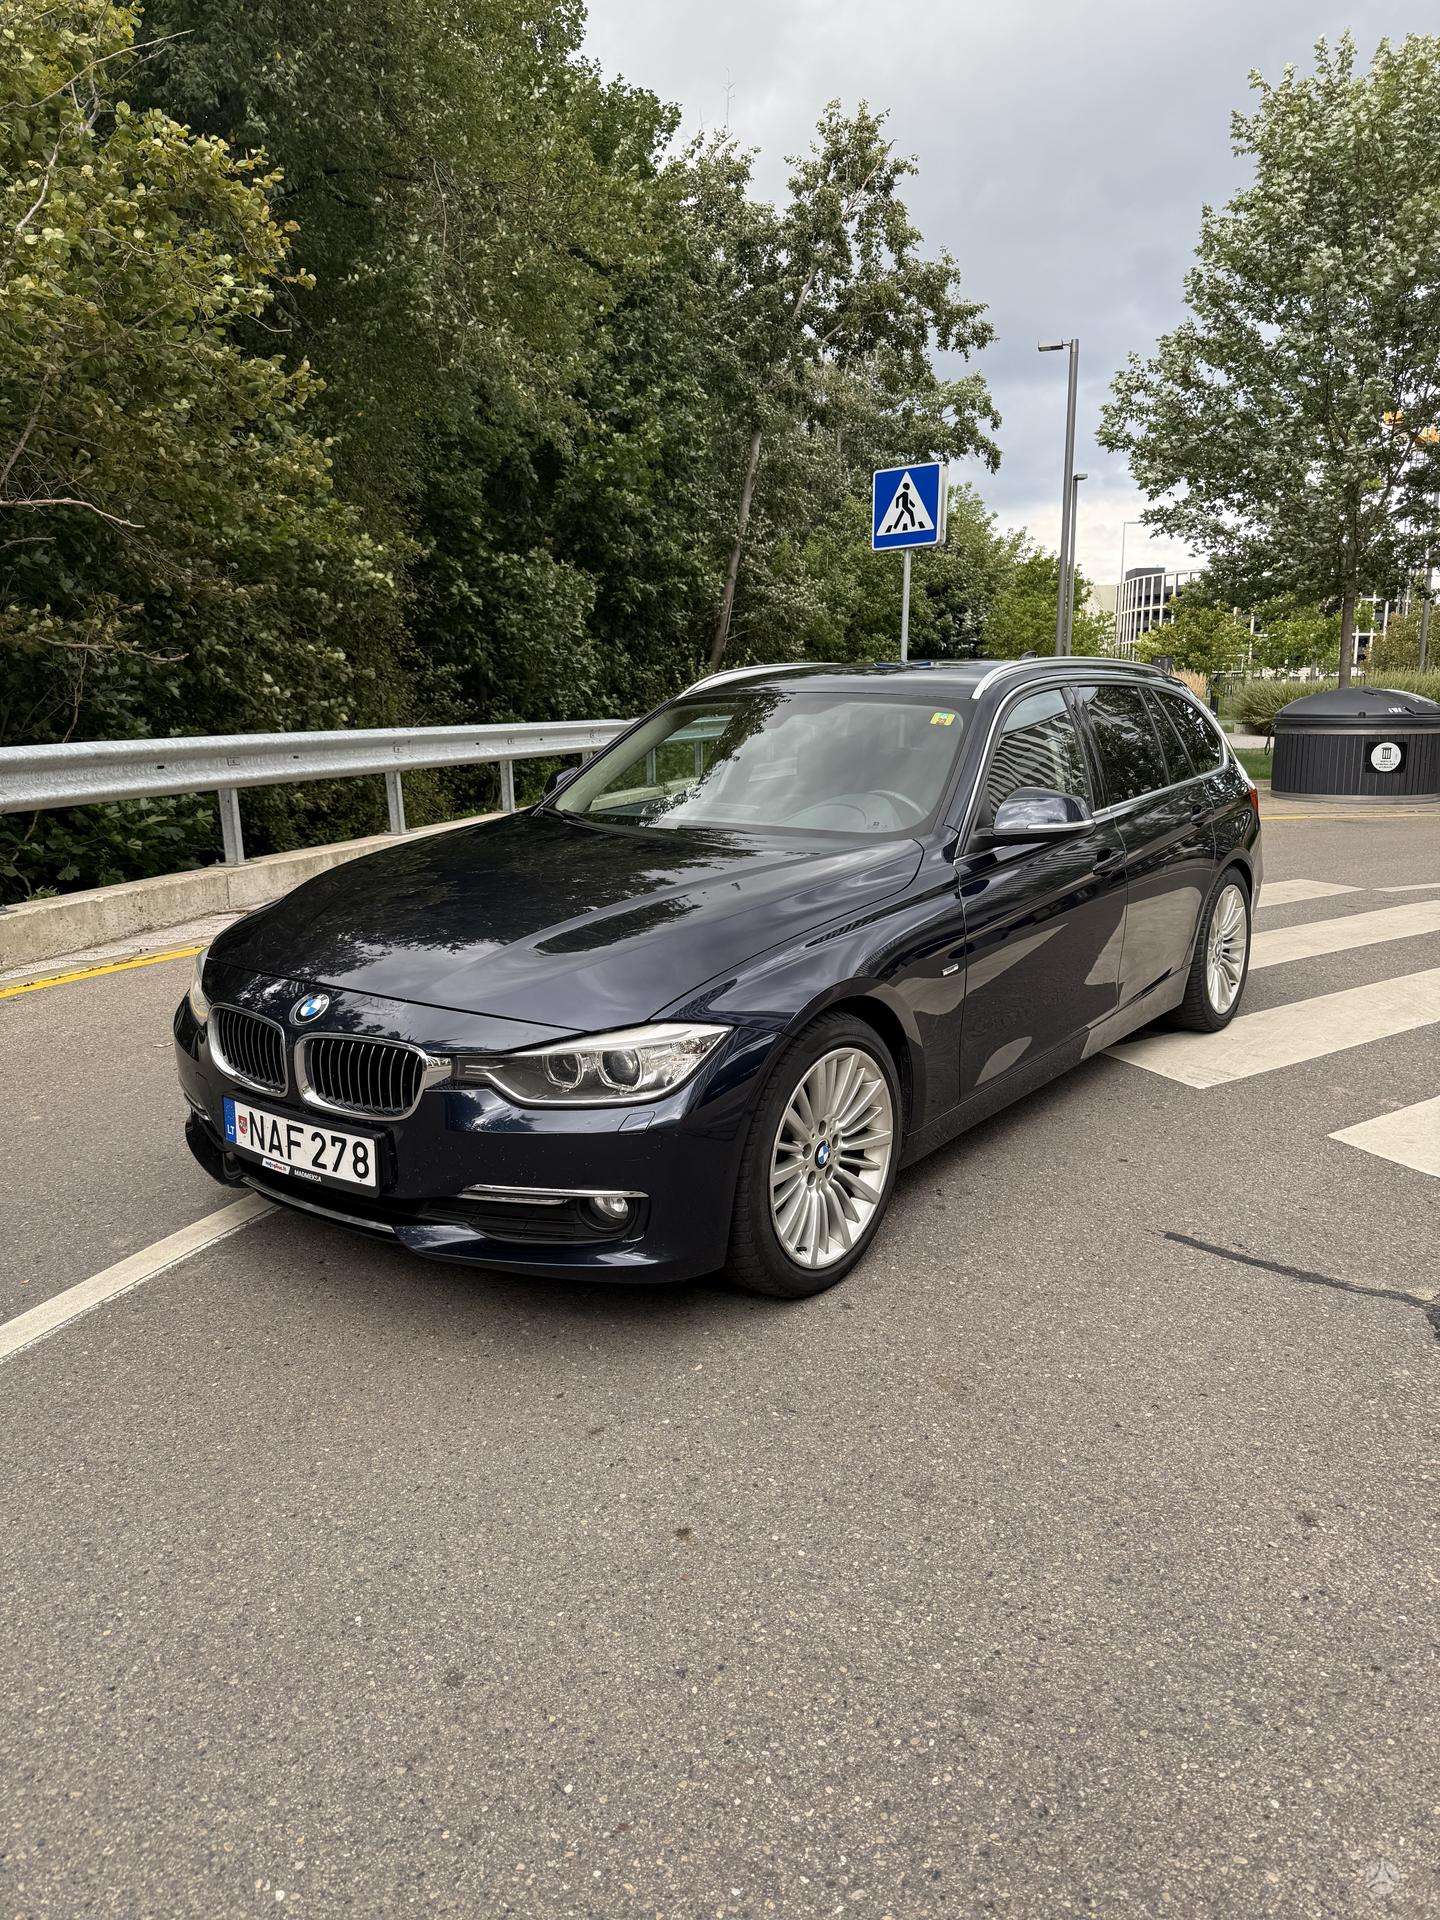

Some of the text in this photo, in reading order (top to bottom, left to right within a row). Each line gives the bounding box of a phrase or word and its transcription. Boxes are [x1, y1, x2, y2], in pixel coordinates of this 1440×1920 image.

[227, 1124, 235, 1136] LT
[249, 1111, 369, 1179] NAF 278
